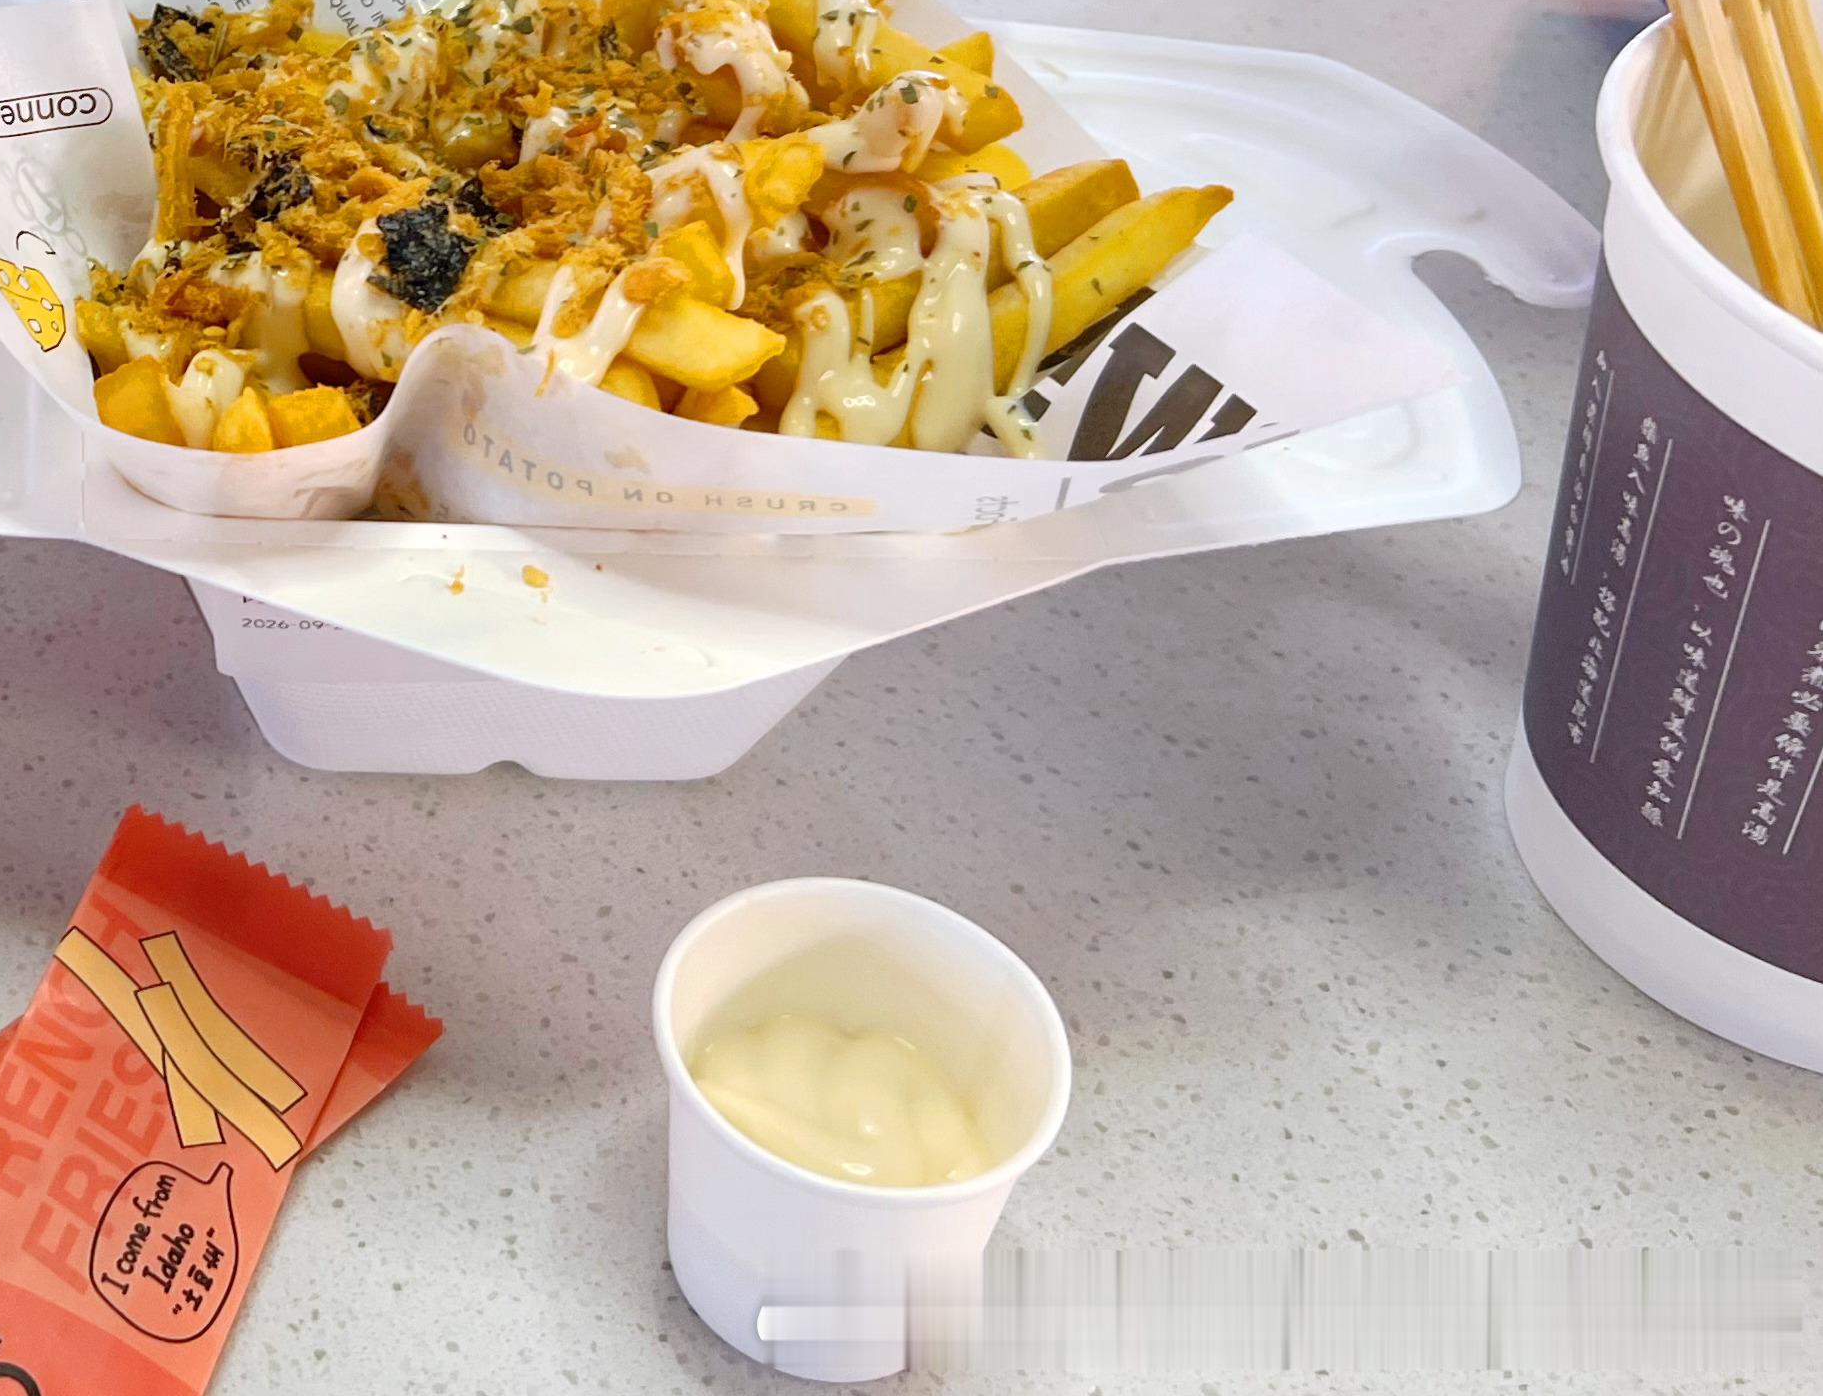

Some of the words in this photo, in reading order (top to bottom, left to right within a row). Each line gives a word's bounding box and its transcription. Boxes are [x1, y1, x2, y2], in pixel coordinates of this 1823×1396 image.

[242, 617, 344, 631] 2026-09-
[133, 1174, 176, 1218] from
[116, 1223, 151, 1275] come
[142, 1223, 195, 1294] Idaho
[101, 1272, 130, 1295] I
